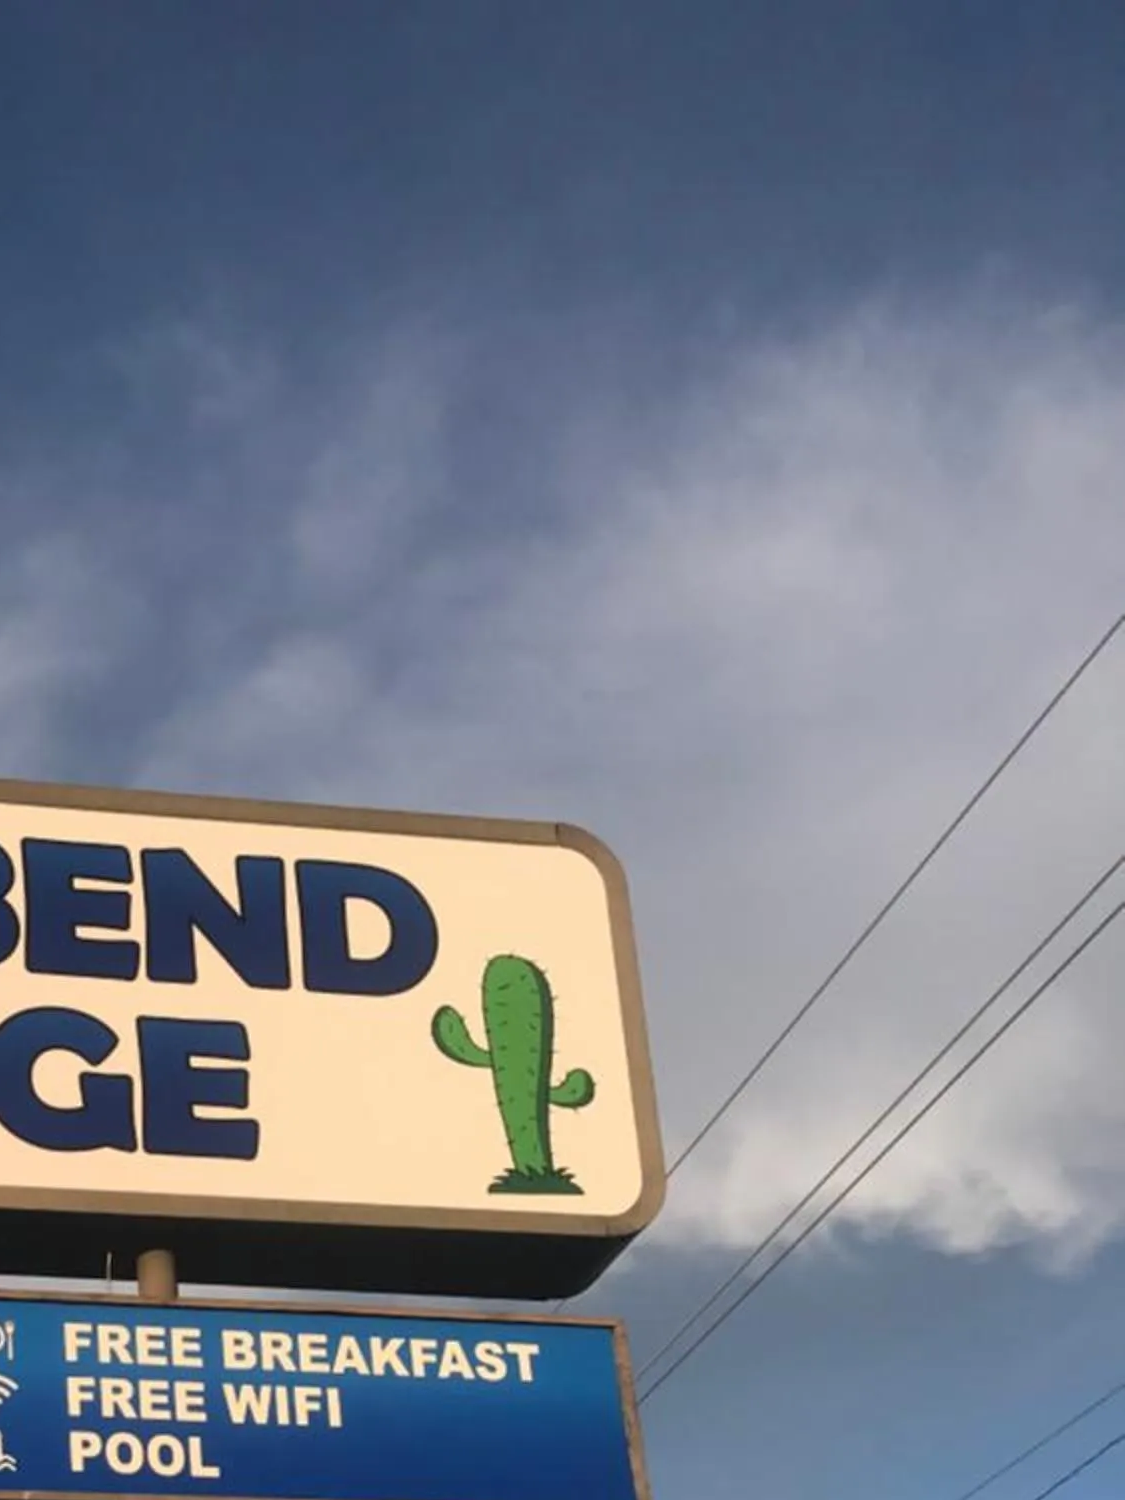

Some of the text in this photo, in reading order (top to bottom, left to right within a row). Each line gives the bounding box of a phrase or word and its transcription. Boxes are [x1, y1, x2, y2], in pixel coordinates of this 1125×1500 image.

[63, 1322, 540, 1384] FREE BREAKFAST
[66, 1376, 342, 1428] FREE WIFI
[69, 1430, 221, 1478] POOL
